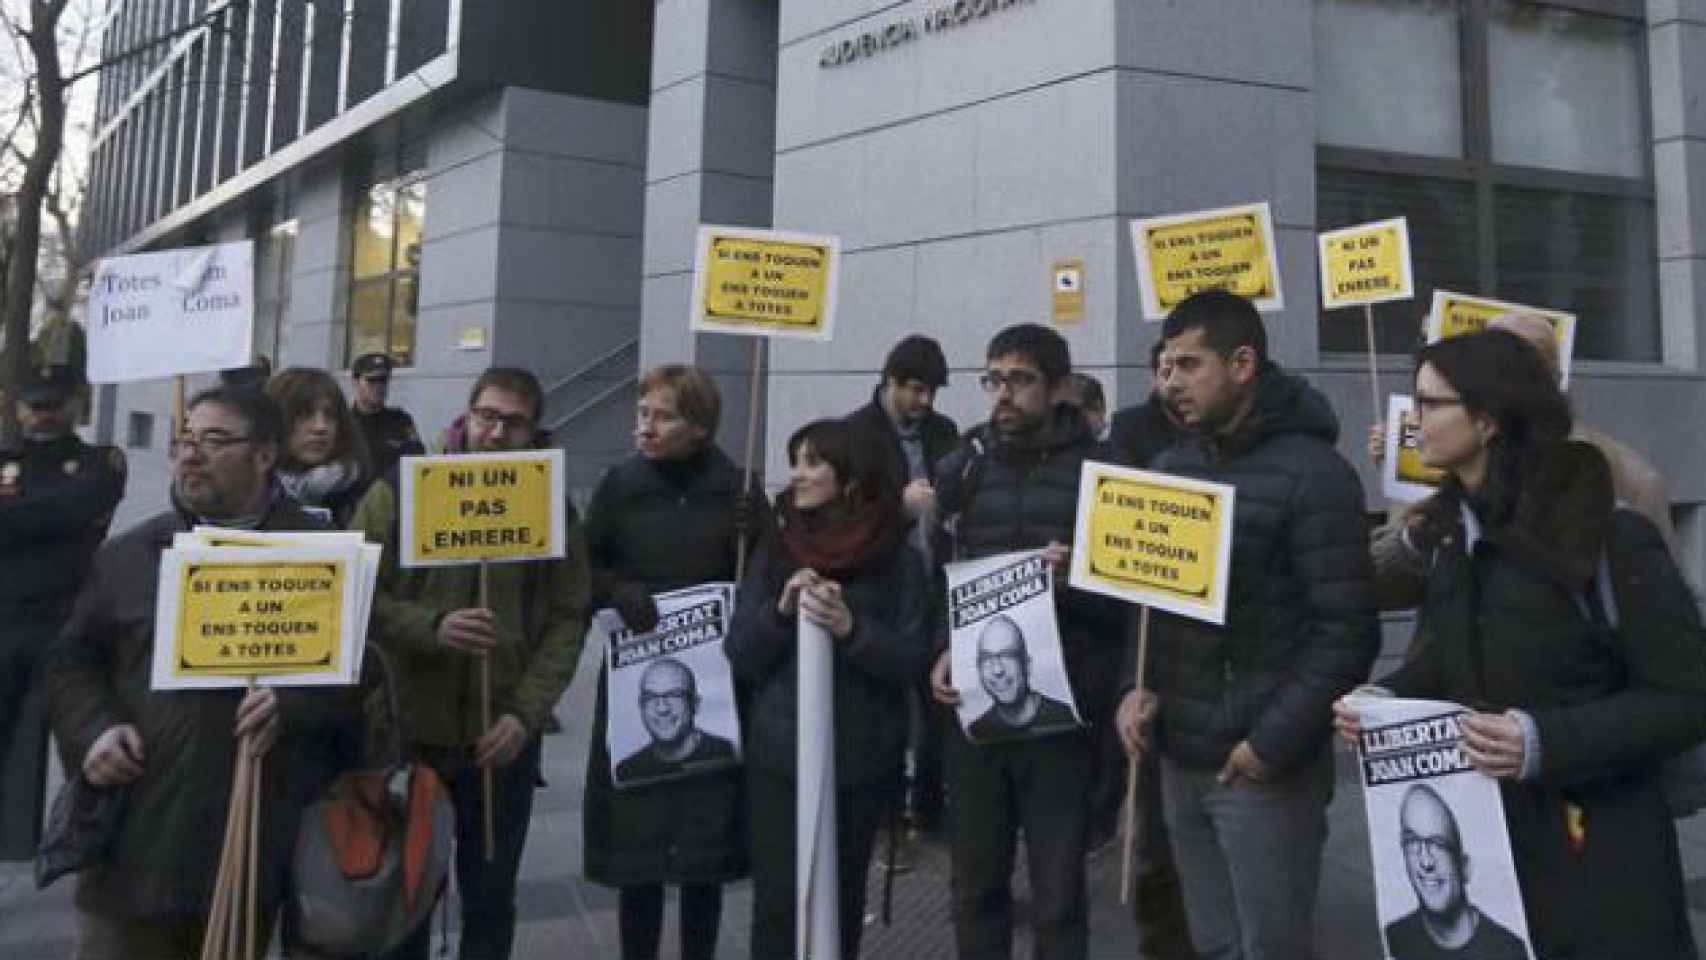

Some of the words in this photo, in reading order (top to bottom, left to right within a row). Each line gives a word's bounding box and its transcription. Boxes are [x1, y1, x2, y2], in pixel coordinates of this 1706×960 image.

[1360, 237, 1379, 249] UN
[1348, 257, 1376, 271] PAS
[102, 273, 162, 294] Totes
[1338, 276, 1390, 294] ENRERE
[102, 303, 150, 328] Joan
[448, 470, 474, 488] NI
[483, 468, 517, 487] UN
[460, 499, 508, 516] PAS
[1102, 491, 1114, 503] SI
[1116, 495, 1144, 511] ENS
[1151, 500, 1211, 521] TOQUEN
[1136, 518, 1144, 530] A
[1149, 522, 1168, 535] UN
[434, 527, 531, 548] ENRERE
[1106, 534, 1133, 549] ENS
[1138, 540, 1199, 562] TOQUEN
[1118, 560, 1127, 569] A
[1132, 559, 1179, 579] TOTES
[192, 580, 211, 594] SI
[215, 580, 251, 593] ENS
[257, 577, 331, 592] TOQUEN
[238, 601, 250, 612] A
[256, 601, 283, 612] UN
[958, 598, 997, 625] JOAN
[1000, 577, 1044, 605] COMA
[202, 622, 236, 636] ENS
[244, 621, 319, 636] TOQUEN
[665, 623, 718, 651] COMA
[219, 644, 231, 657] A
[237, 643, 297, 657] TOTES
[1364, 716, 1460, 753] LLIBERTA
[1369, 756, 1415, 781] JOAN
